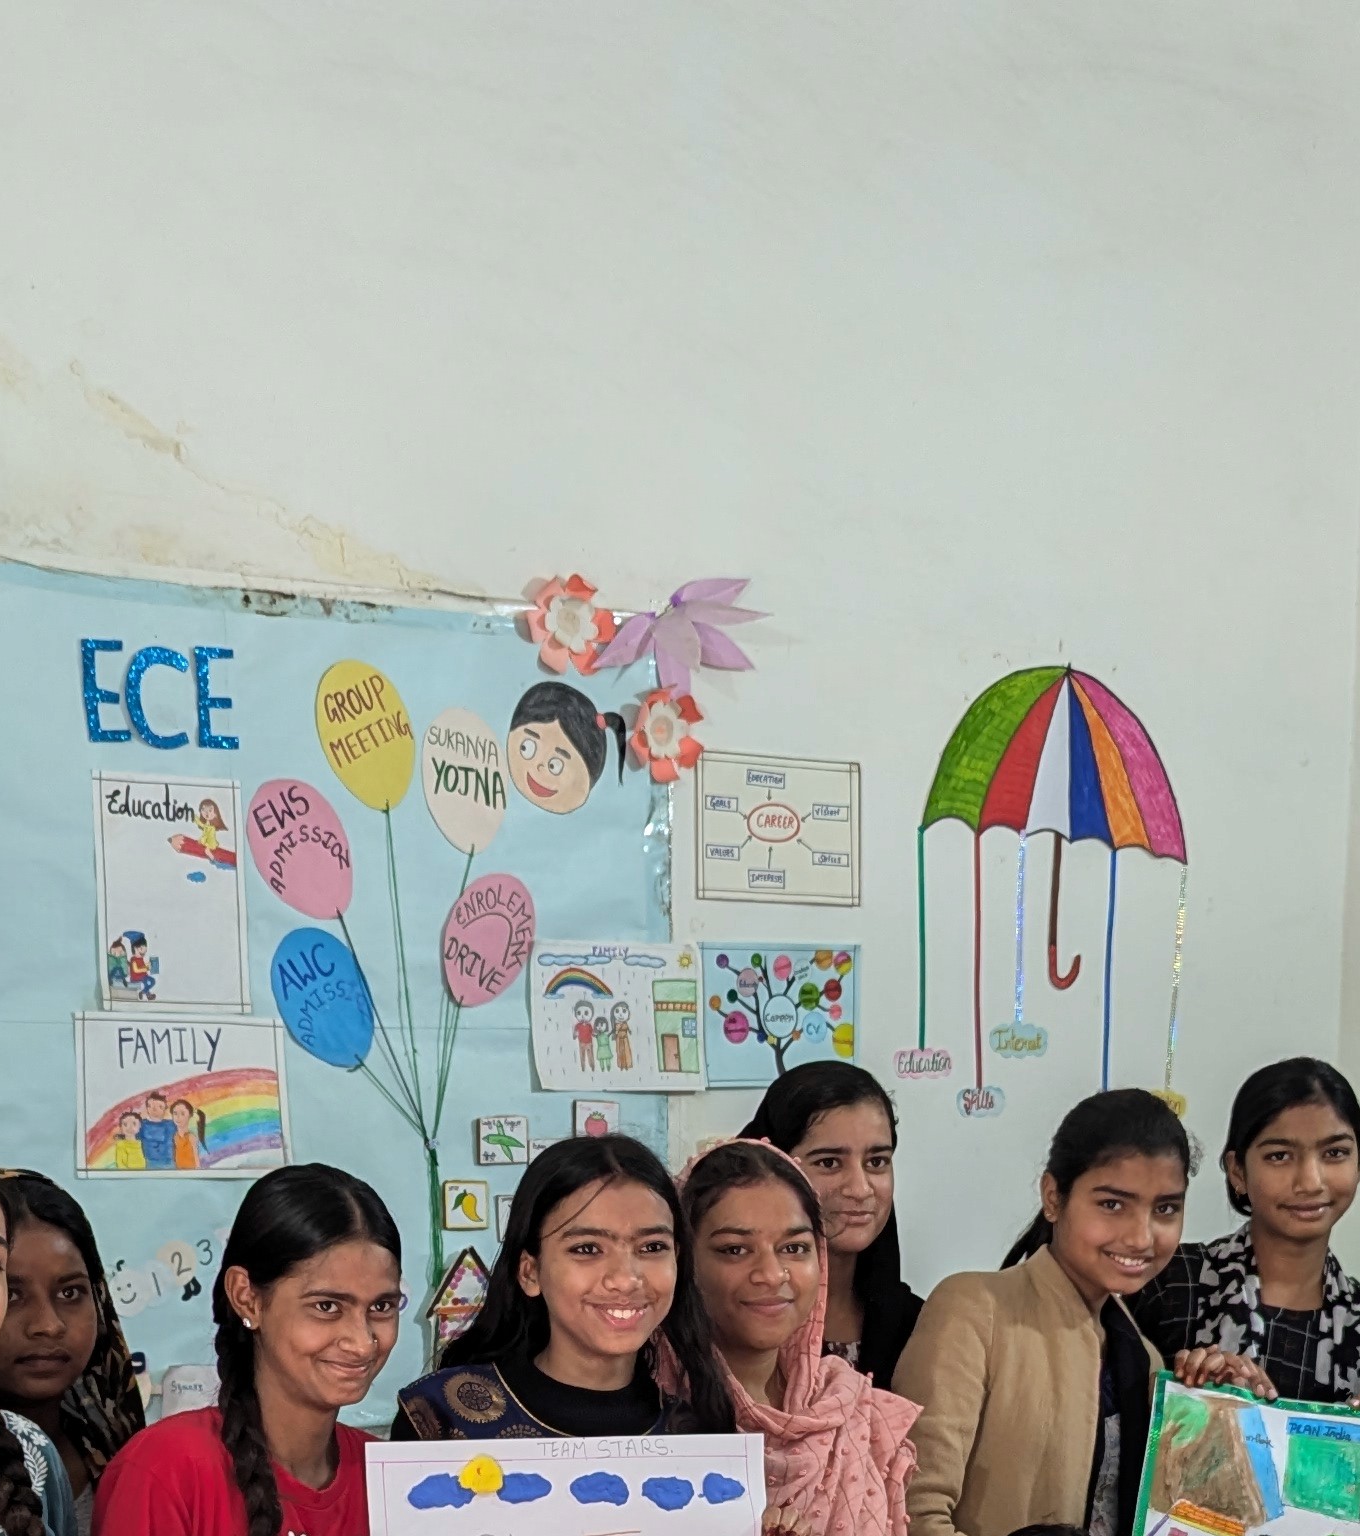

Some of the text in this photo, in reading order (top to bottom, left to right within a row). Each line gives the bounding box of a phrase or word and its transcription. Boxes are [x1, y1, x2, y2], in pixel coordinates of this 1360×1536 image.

[79, 638, 240, 751] ECE
[322, 673, 386, 724] GROUP
[327, 709, 413, 767] MEETING
[426, 724, 500, 767] SUKANYA
[105, 787, 196, 824] Education
[430, 756, 508, 811] YOJNA
[252, 785, 311, 840] EWS
[756, 814, 795, 829] CAREER
[269, 825, 351, 894] ADMISSION
[454, 884, 535, 968] ENROLEMENT
[278, 943, 335, 1001] AWC
[444, 936, 505, 992] DRIVE
[592, 946, 629, 957] FAMILY
[118, 1026, 222, 1072] FAMILY
[897, 1053, 952, 1075] Education
[962, 1088, 995, 1115] Skills
[170, 1251, 192, 1277] 2
[196, 1239, 213, 1266] 3
[539, 1441, 587, 1459] TEAM
[1290, 1423, 1320, 1437] PLAN
